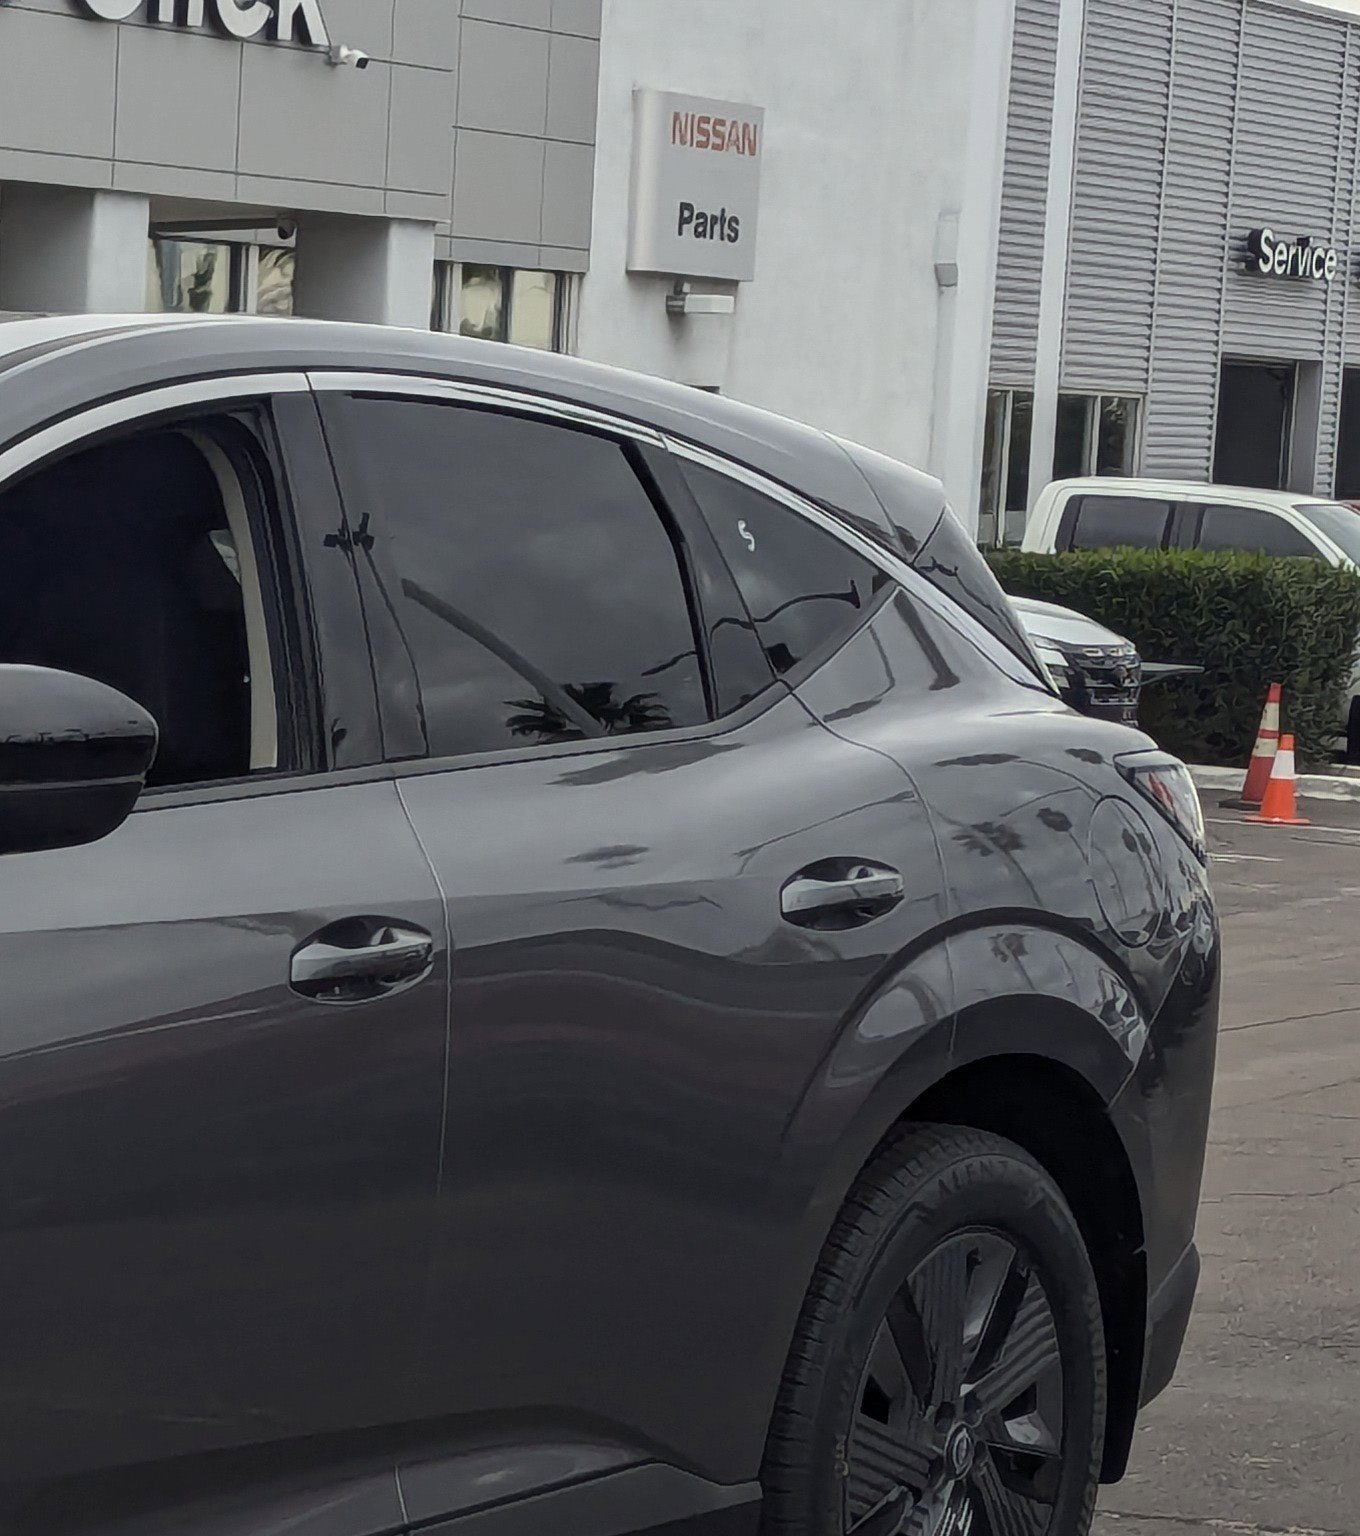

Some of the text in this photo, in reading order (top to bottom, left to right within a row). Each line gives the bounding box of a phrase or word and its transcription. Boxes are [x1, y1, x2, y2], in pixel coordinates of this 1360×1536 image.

[671, 111, 758, 157] NISSAN
[677, 201, 741, 244] Parts
[1257, 227, 1338, 281] Service
